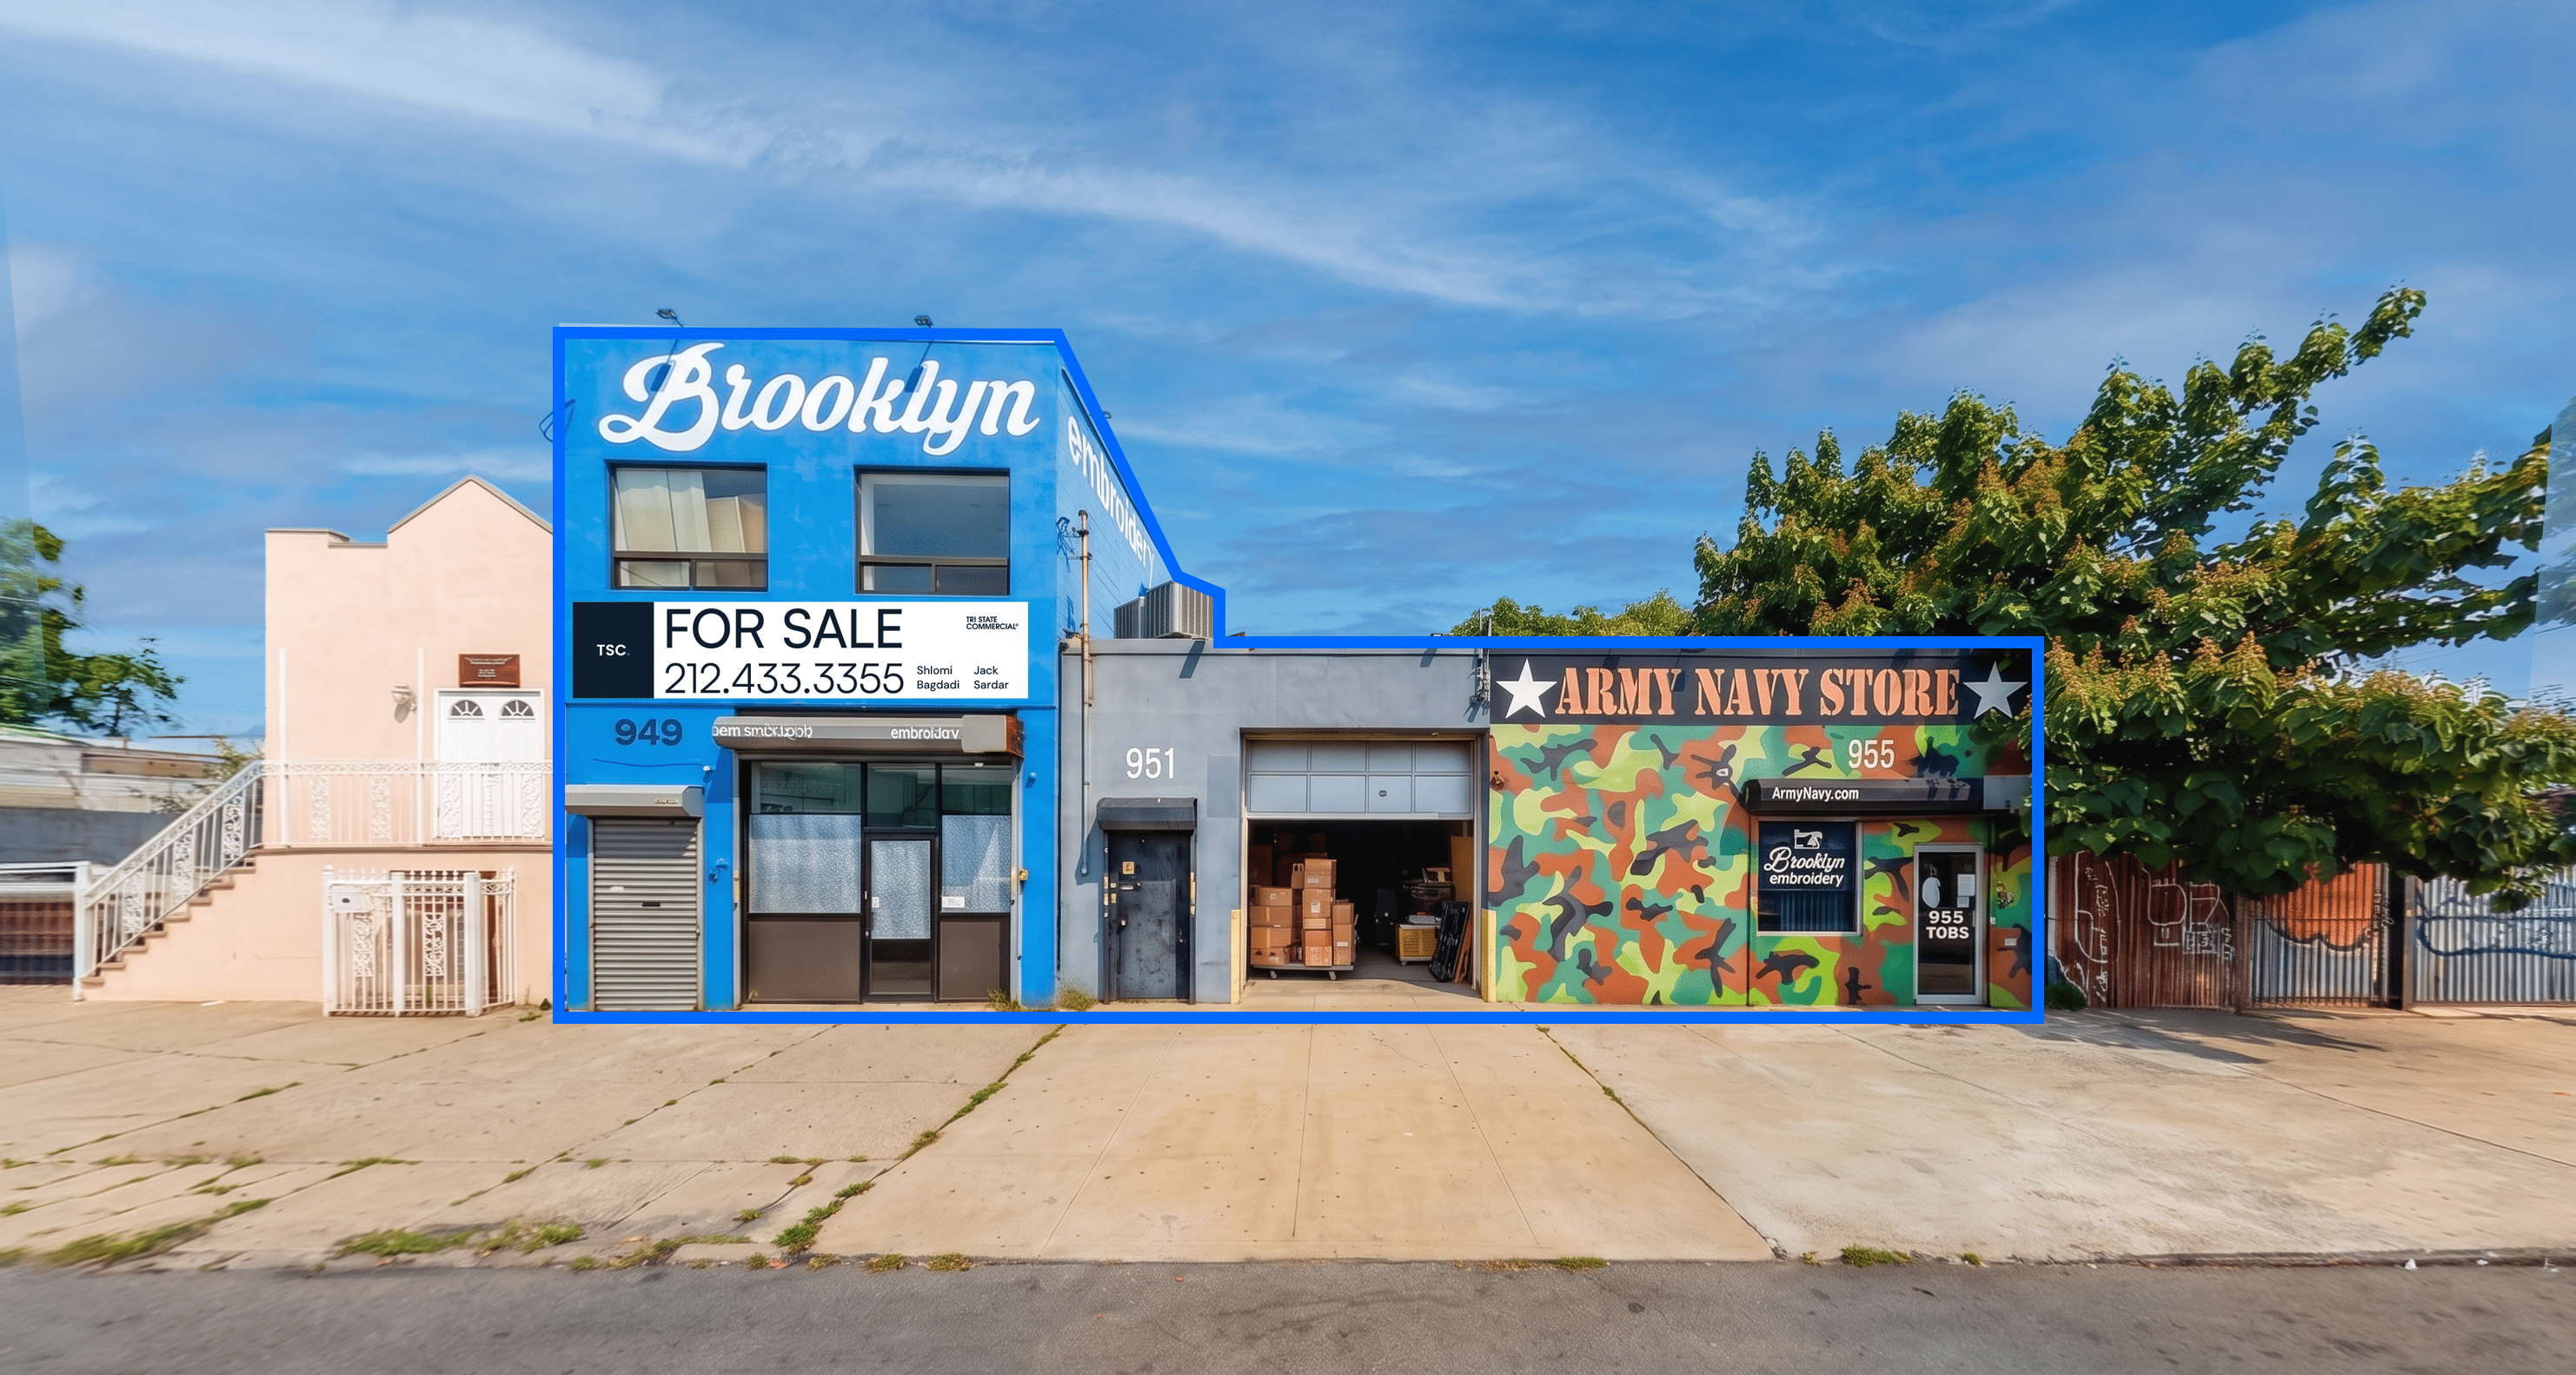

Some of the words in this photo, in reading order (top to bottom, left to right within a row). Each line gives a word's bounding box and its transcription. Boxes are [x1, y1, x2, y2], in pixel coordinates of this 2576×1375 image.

[599, 342, 1039, 456] Brooklyn
[1068, 415, 1155, 589] embroidery
[667, 608, 765, 649] FOR
[784, 608, 903, 649] SALE
[665, 662, 905, 694] 212.433.3355
[917, 665, 953, 675] Shlomi
[973, 665, 999, 675] Jack
[917, 680, 960, 692] Bagdadi
[973, 680, 1010, 689] Sardar
[1555, 667, 1682, 716] ARMY
[1694, 668, 1809, 716] NAVY
[1819, 668, 1960, 717] STORE
[614, 717, 683, 747] 949
[1125, 747, 1174, 780] 951
[1848, 739, 1895, 769] 955
[1772, 787, 1860, 802] ArmyNavy.com
[1763, 846, 1846, 873] Brooklyn
[1769, 872, 1844, 887] embroidery
[1929, 910, 1964, 925] 955
[1925, 926, 1969, 940] TOBS
